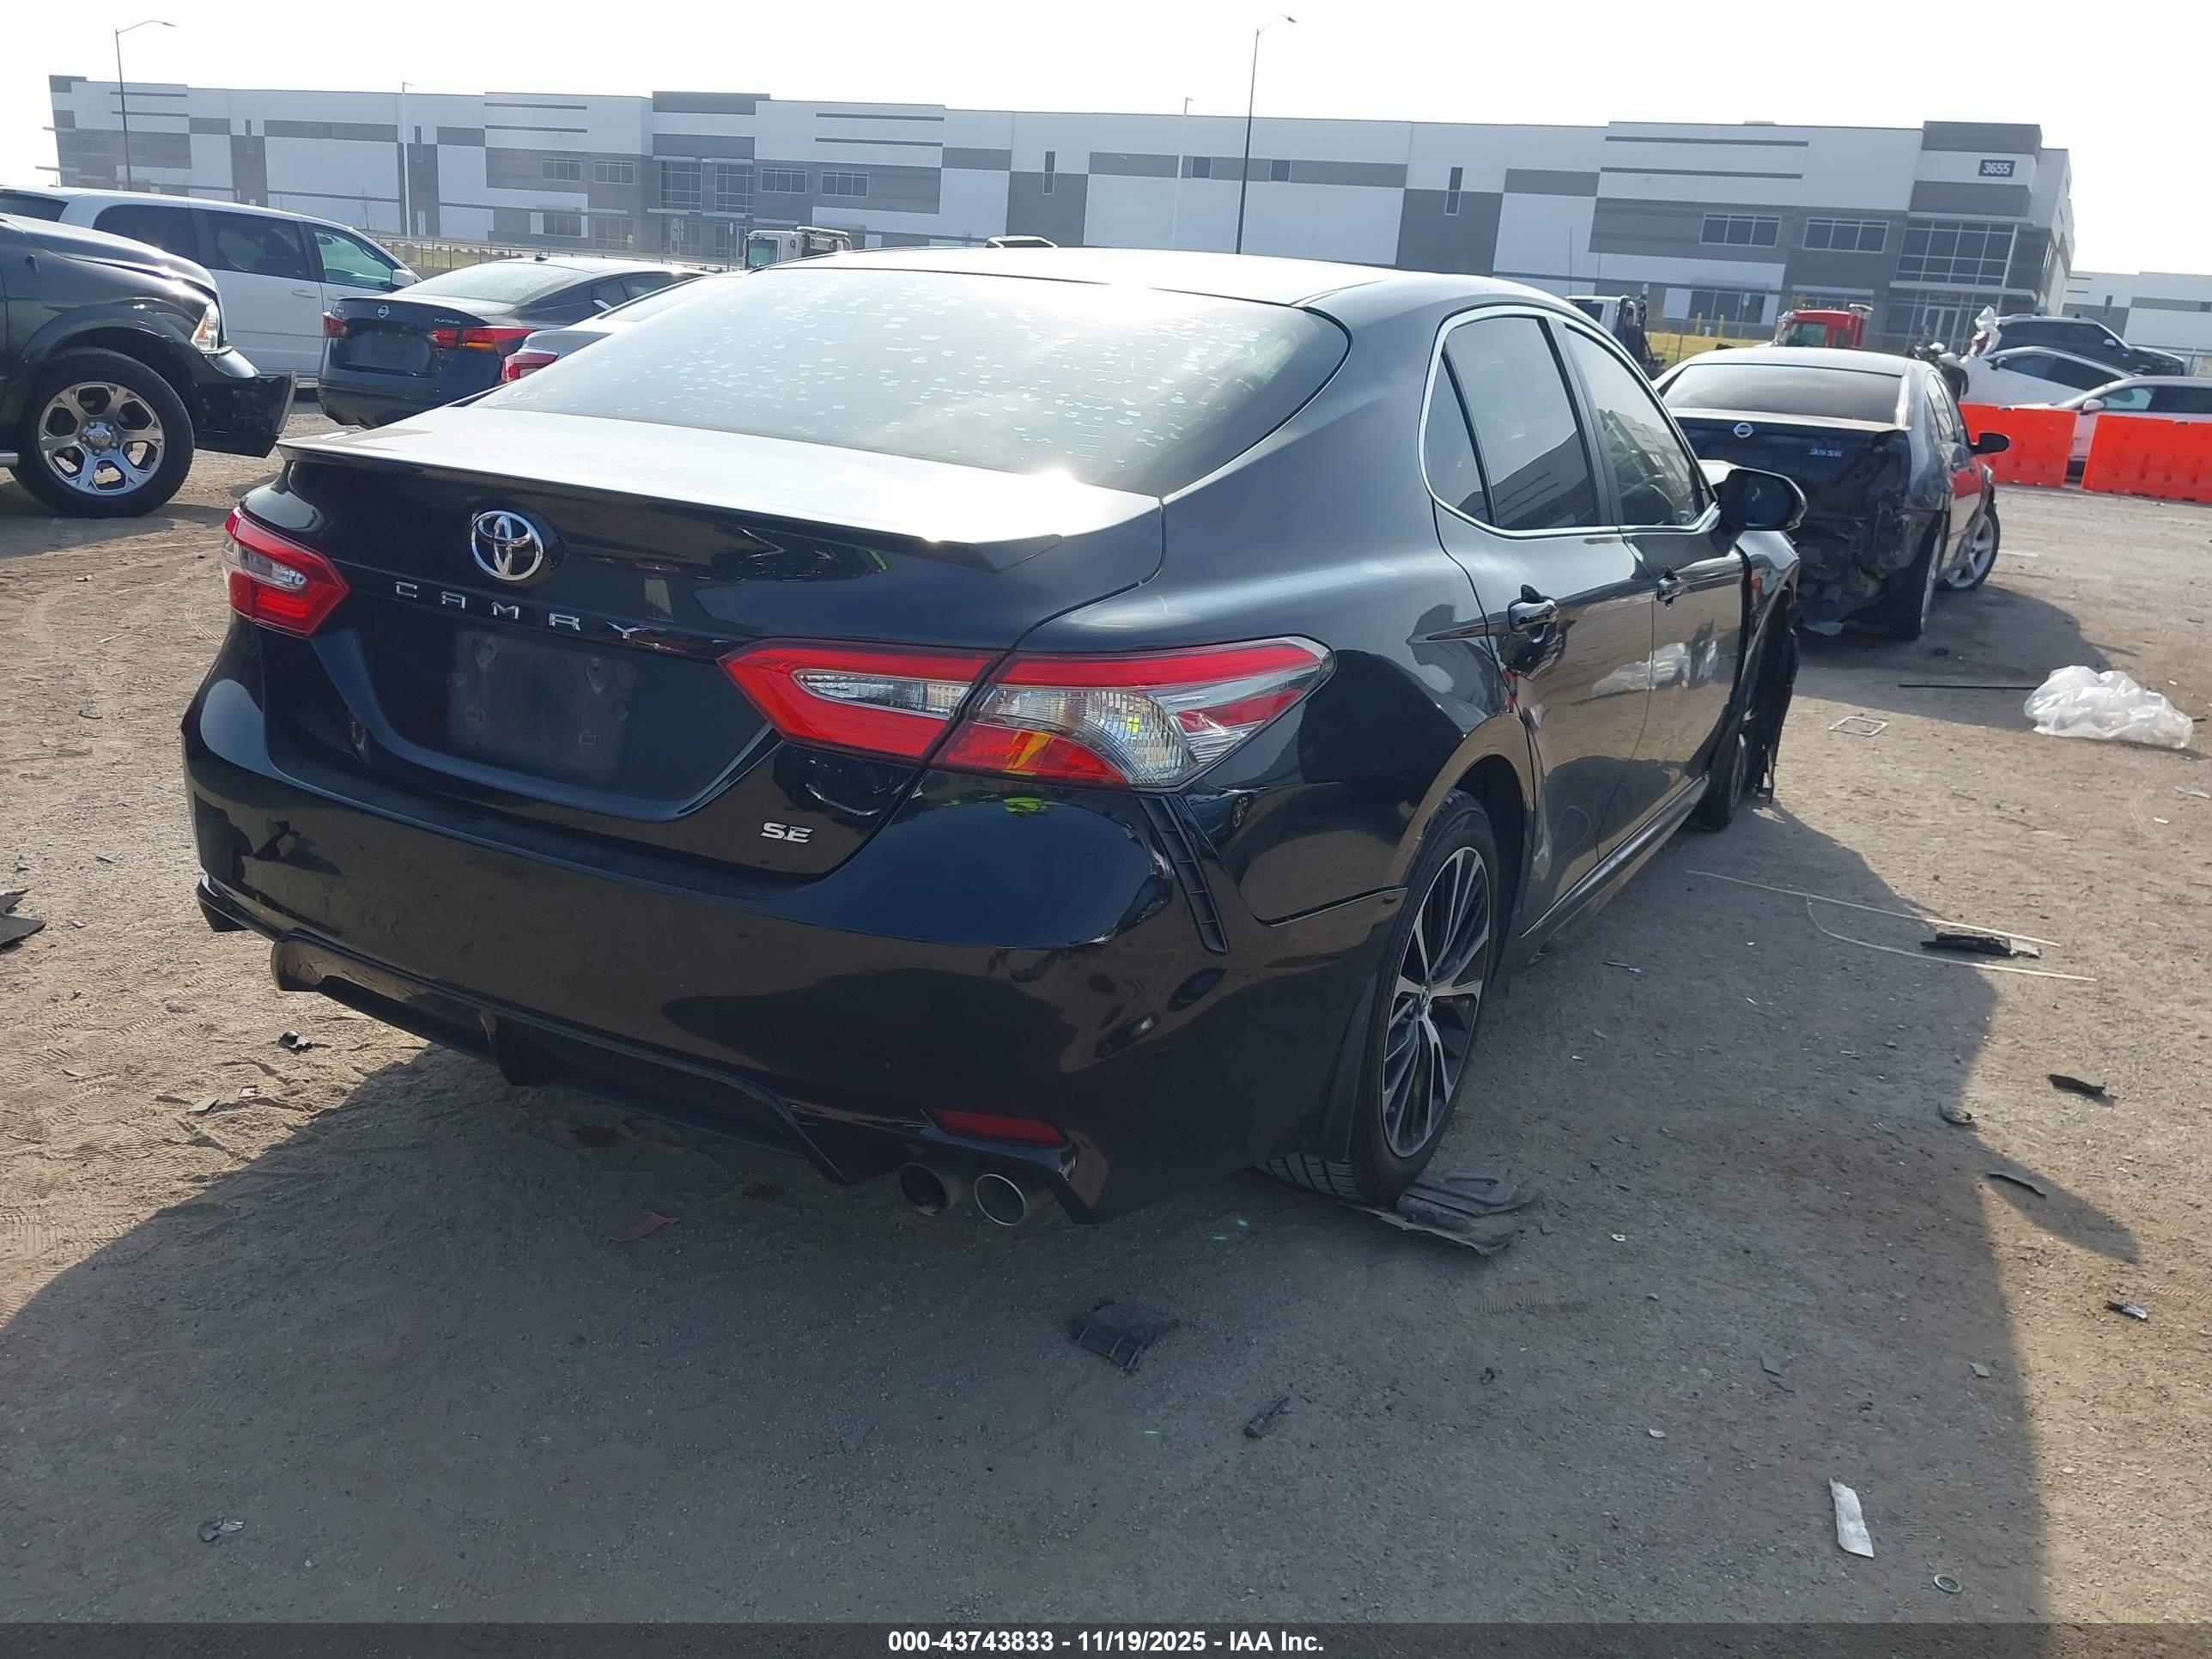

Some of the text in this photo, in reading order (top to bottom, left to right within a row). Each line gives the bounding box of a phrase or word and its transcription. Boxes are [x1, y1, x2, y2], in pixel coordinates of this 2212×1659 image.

[1983, 161, 2010, 175] 3655
[395, 580, 650, 640] CAMRY
[760, 822, 814, 843] SE
